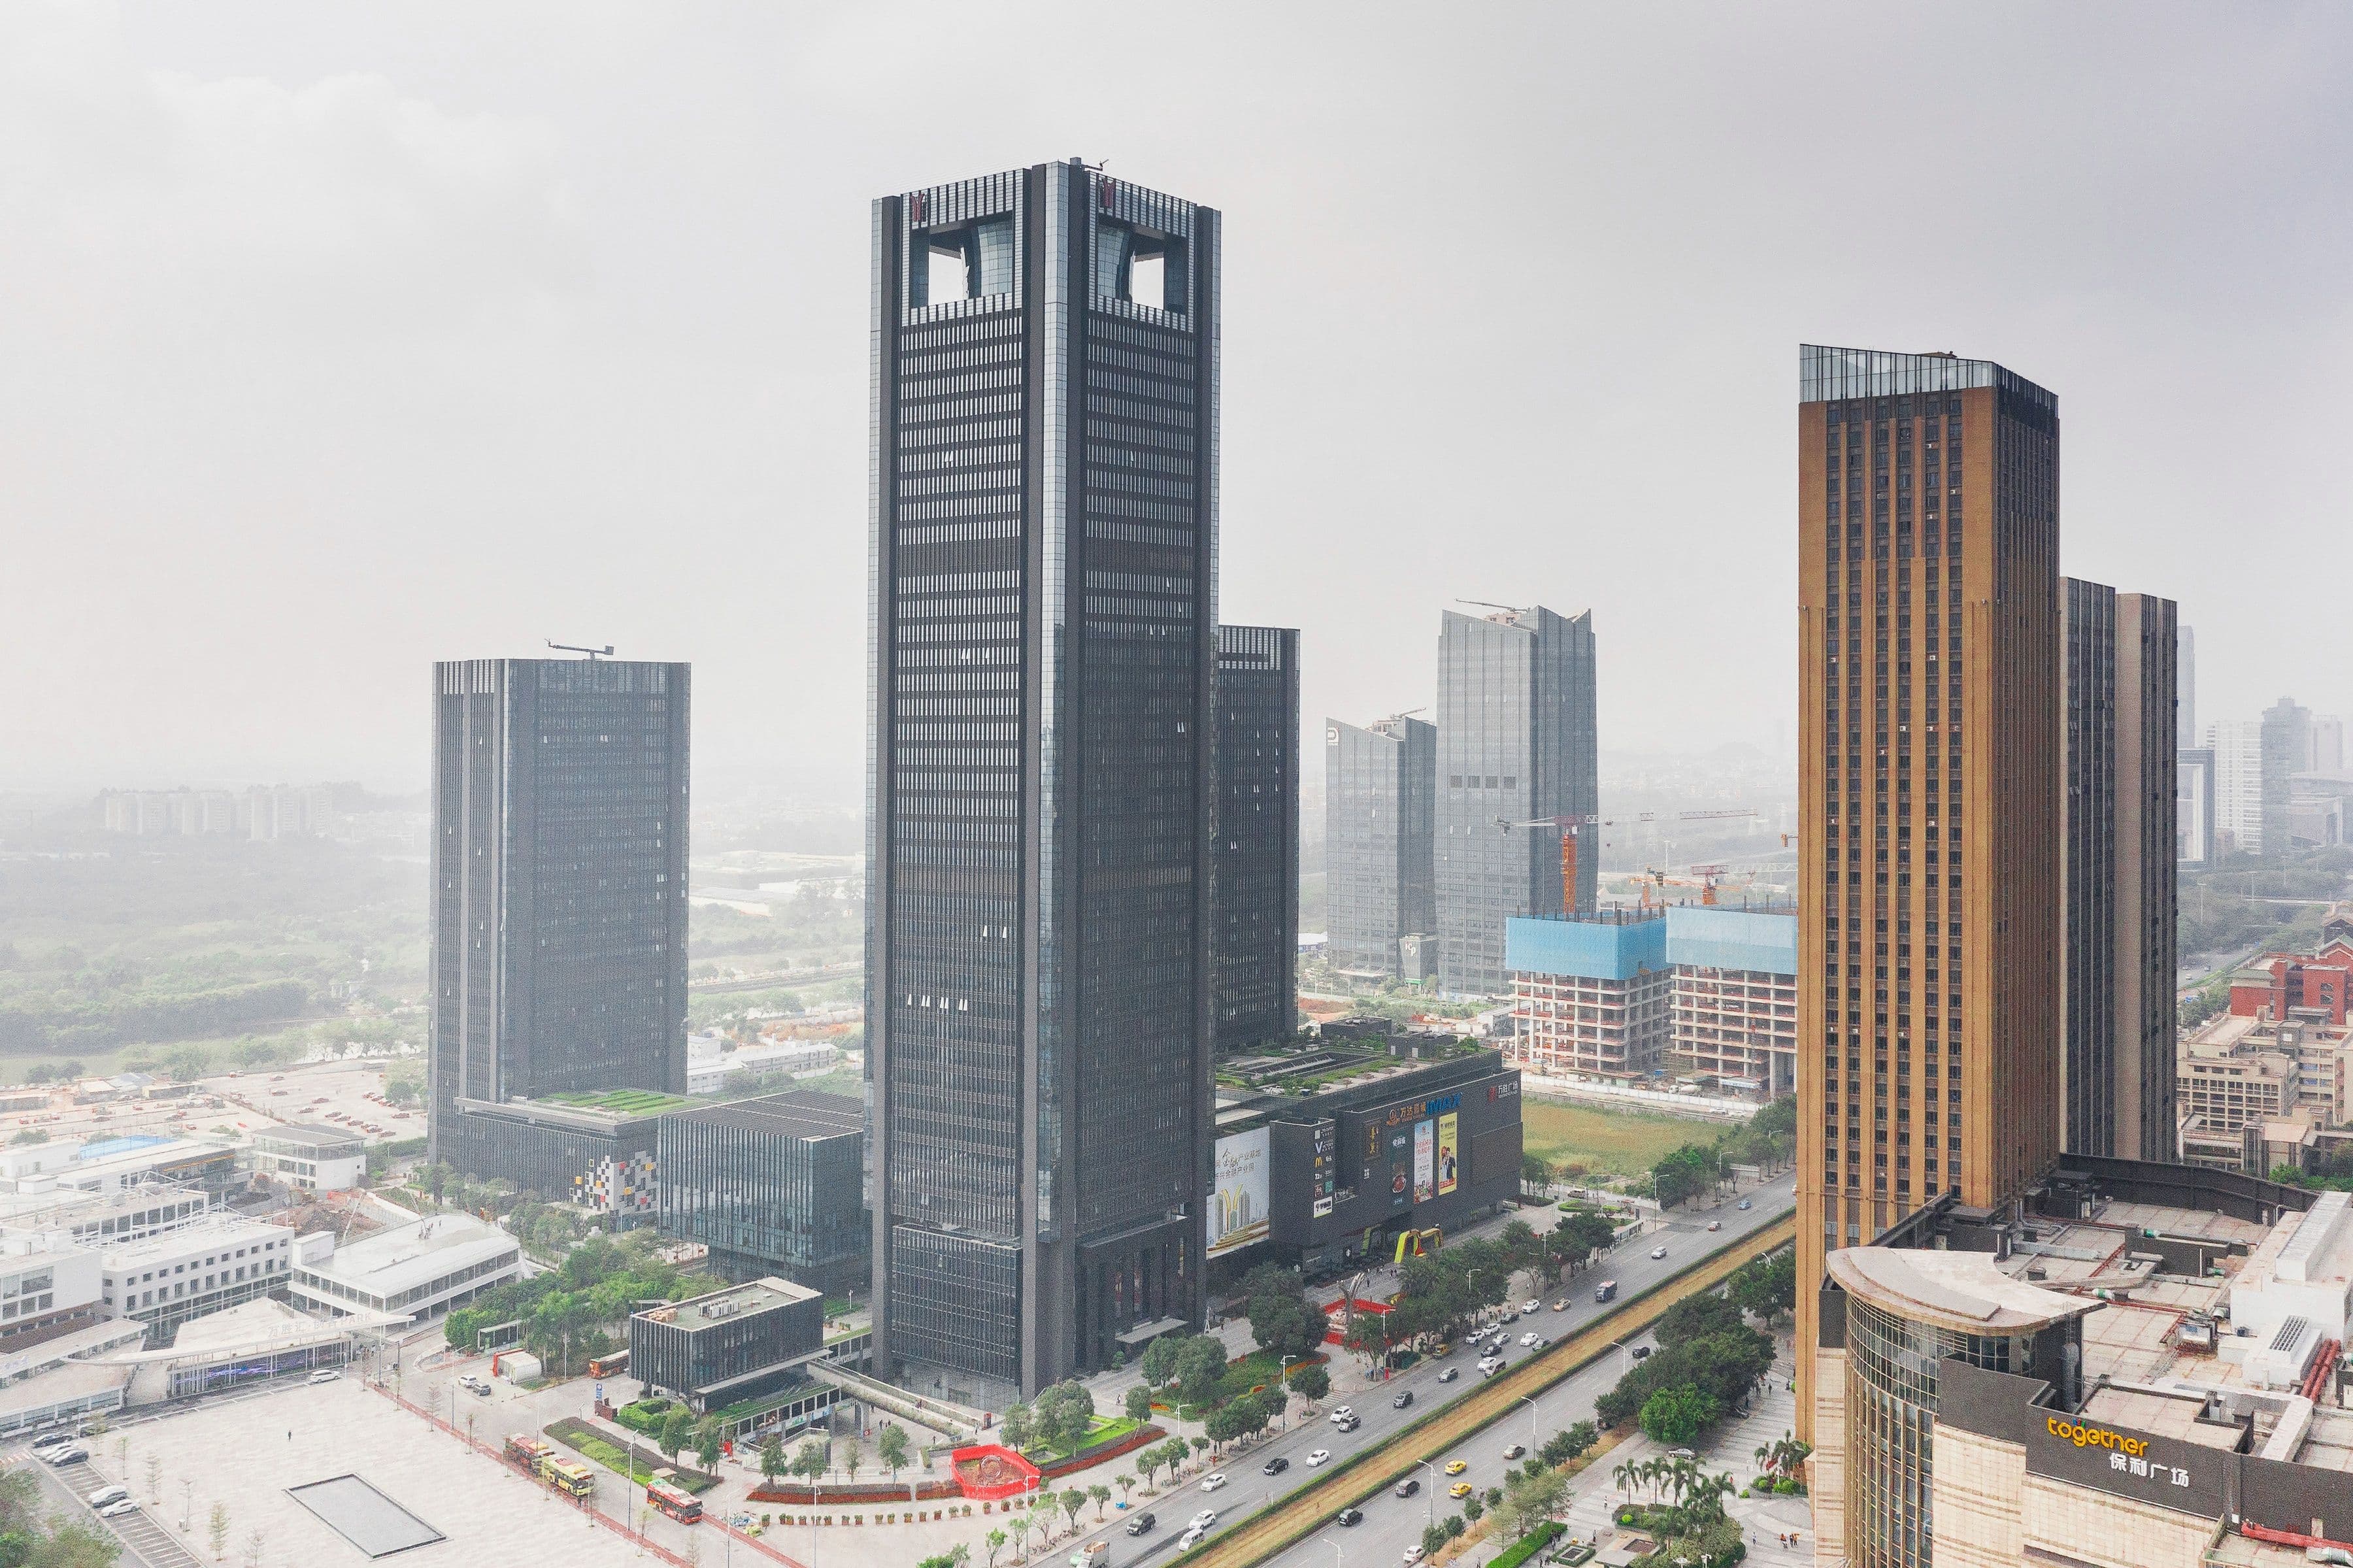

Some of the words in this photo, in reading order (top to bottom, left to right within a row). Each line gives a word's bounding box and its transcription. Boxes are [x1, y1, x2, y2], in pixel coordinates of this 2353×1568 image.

[1426, 1092, 1462, 1115] IMAX
[341, 1312, 372, 1326] PARK
[2047, 1417, 2149, 1457] together
[2109, 1452, 2190, 1488] 保利广场
